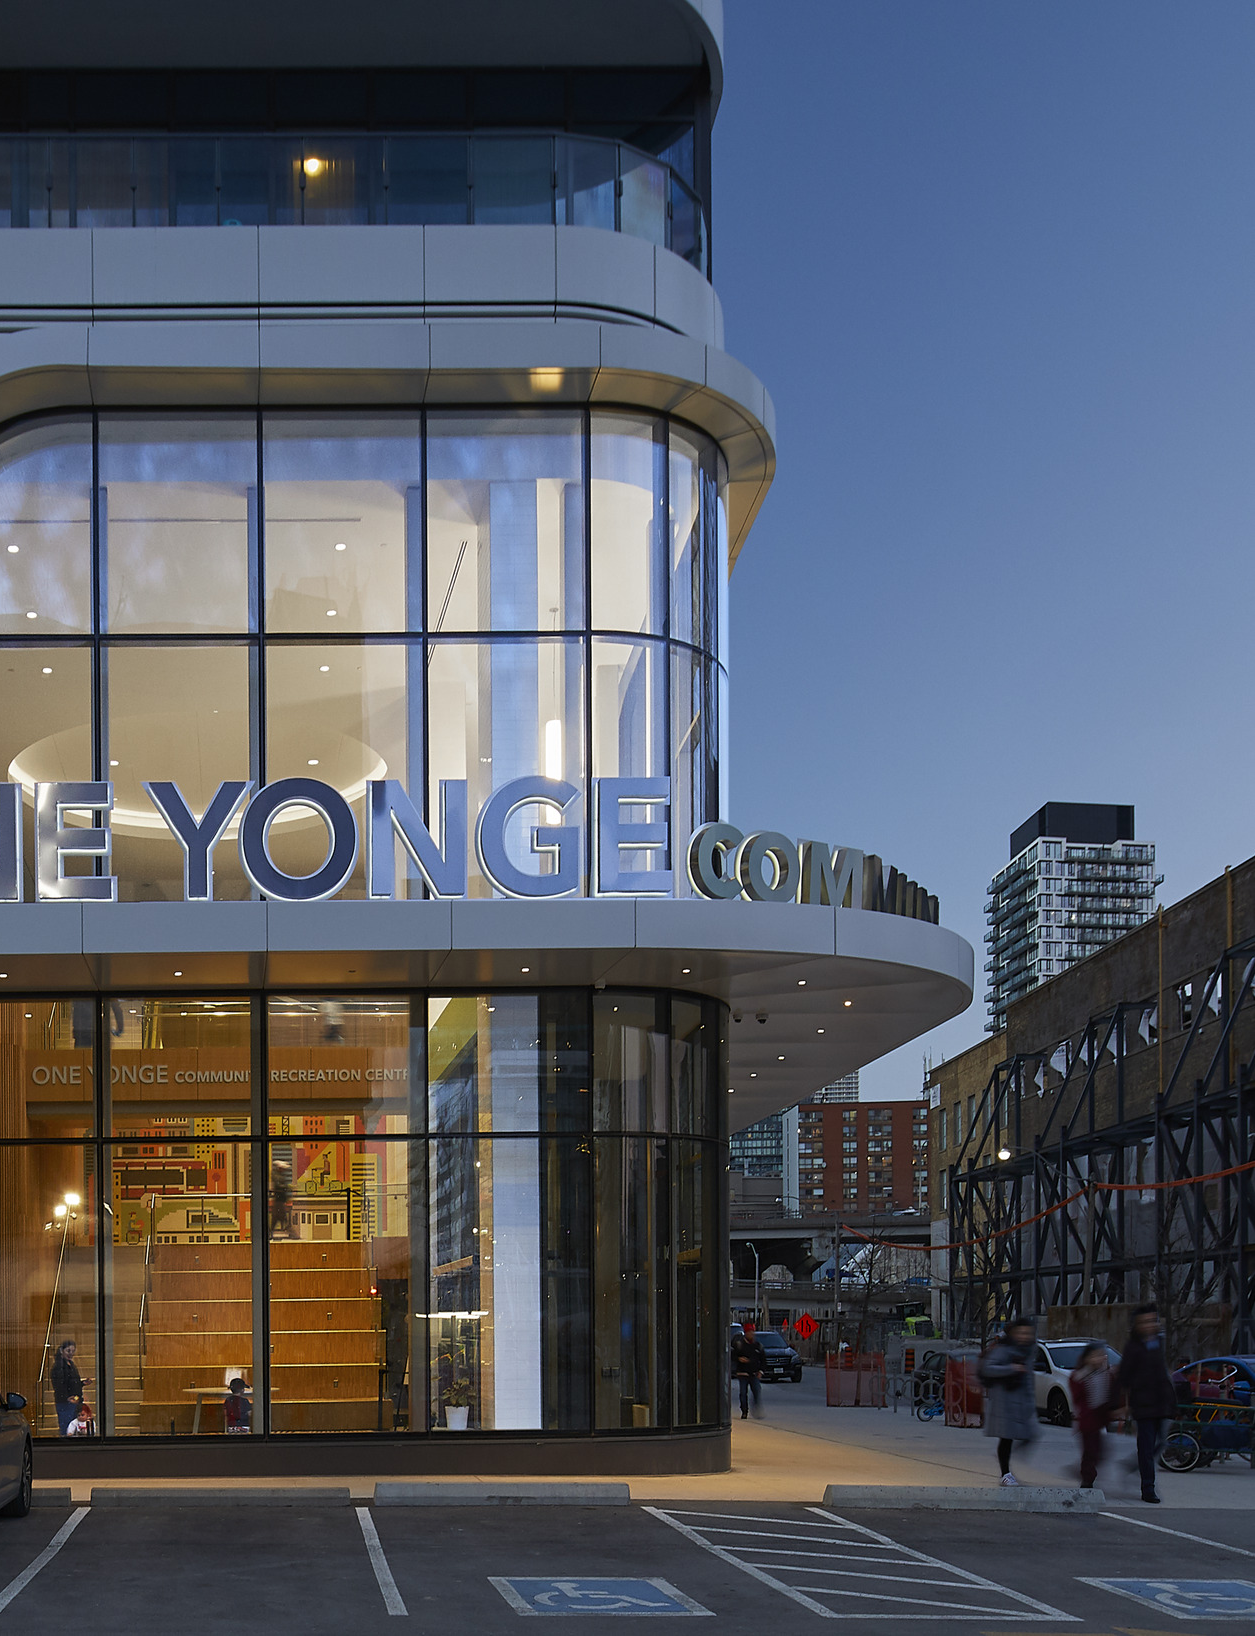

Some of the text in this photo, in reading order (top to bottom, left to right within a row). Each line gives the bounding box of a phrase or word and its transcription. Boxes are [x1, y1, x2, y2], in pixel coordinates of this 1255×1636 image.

[143, 775, 672, 904] YONGE
[32, 1065, 82, 1085] ONE
[174, 1069, 251, 1083] COMMUNI
[270, 1068, 361, 1082] RECREATION
